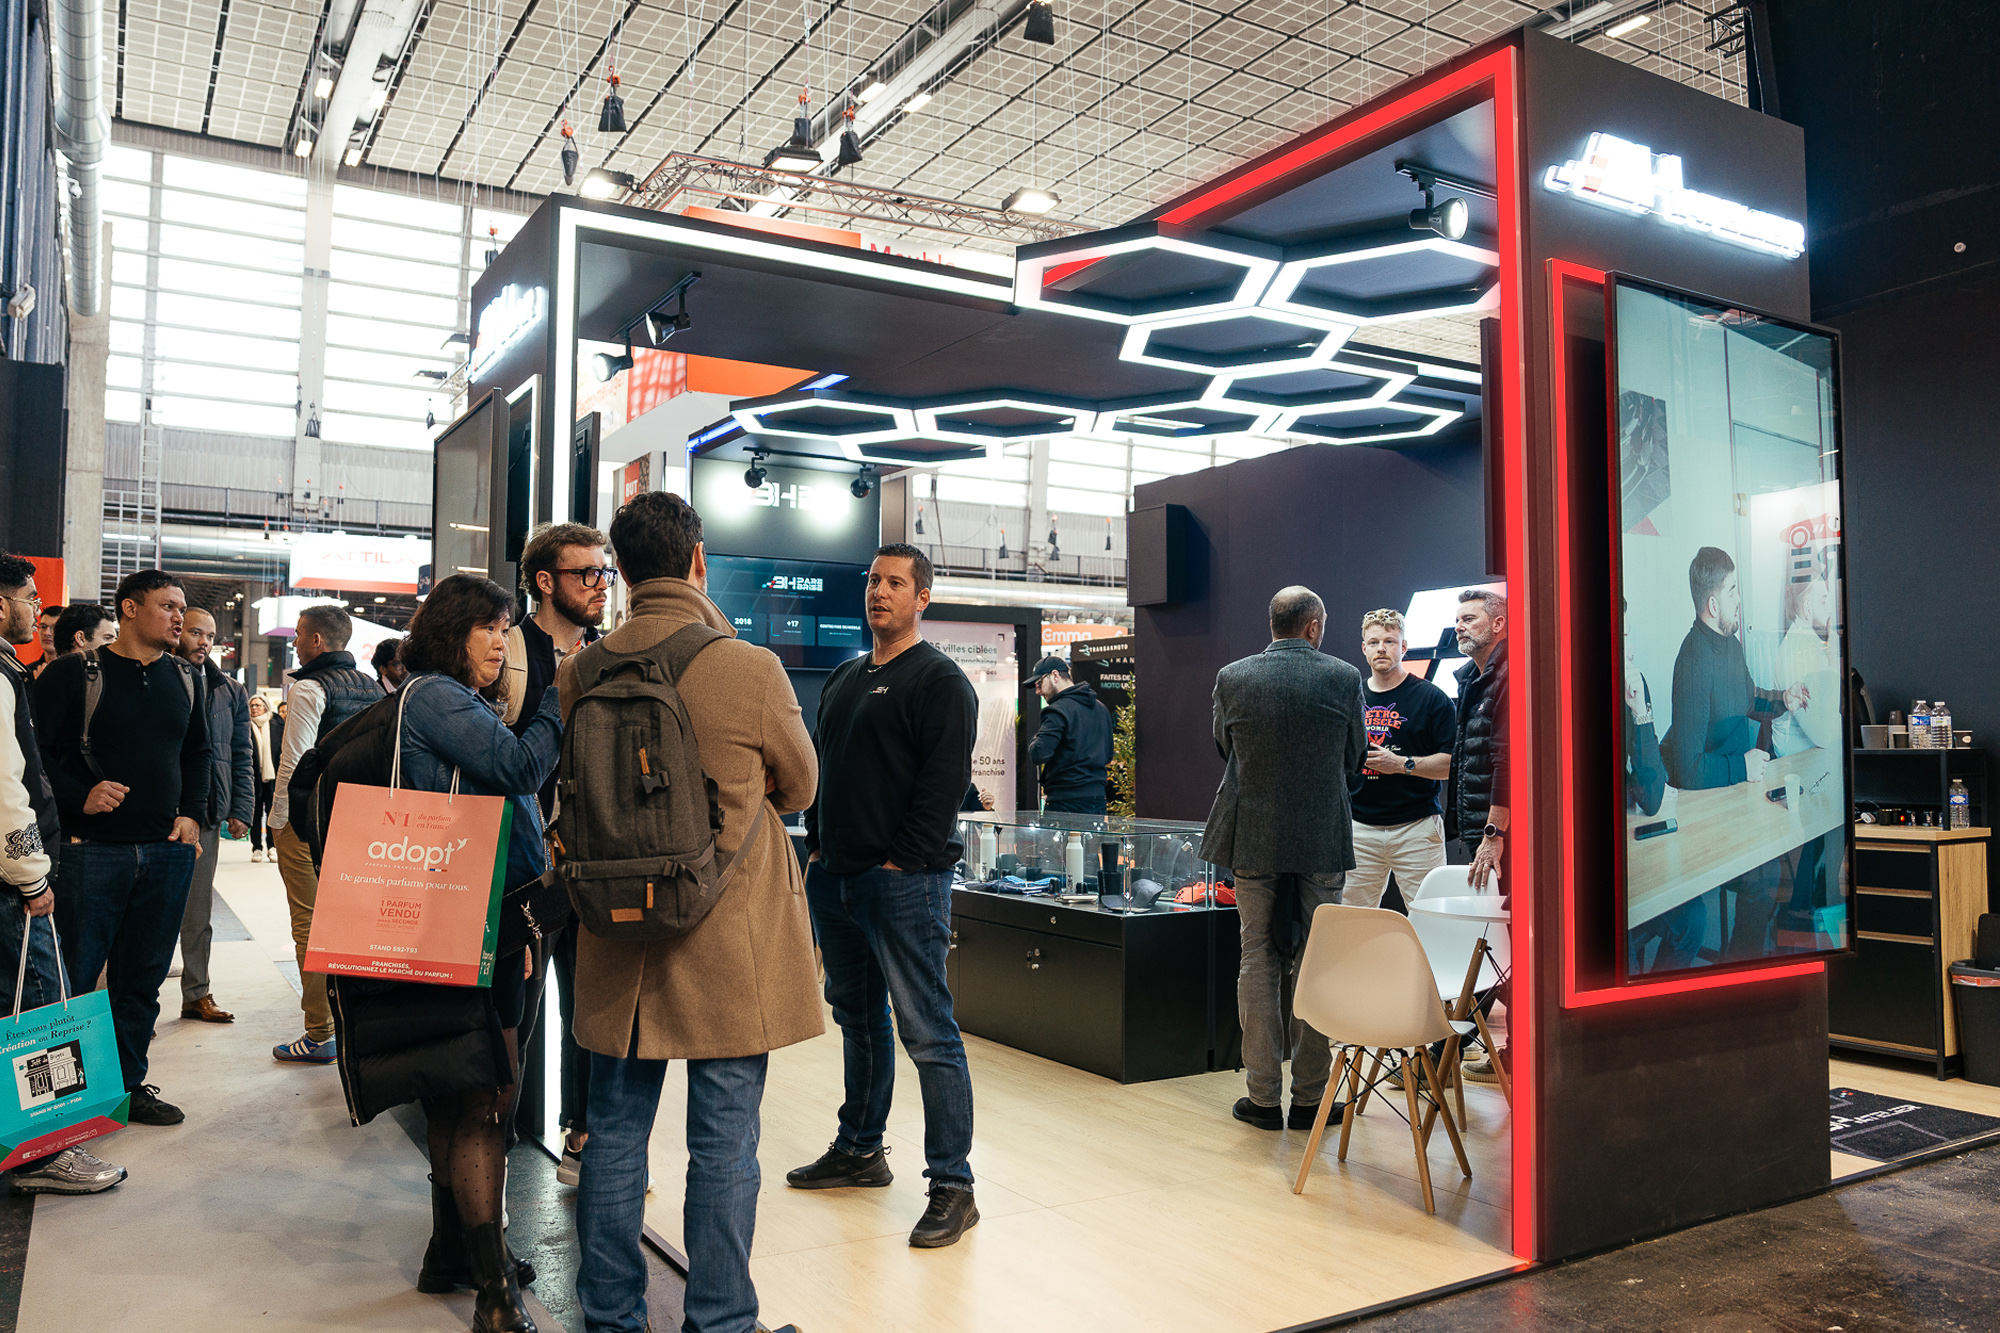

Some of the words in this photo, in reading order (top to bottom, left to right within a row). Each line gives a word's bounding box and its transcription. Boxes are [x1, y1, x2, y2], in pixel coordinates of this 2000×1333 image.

[626, 480, 638, 498] BUT
[943, 644, 966, 653] villes
[968, 645, 998, 654] ciblées
[1364, 710, 1400, 719] ETRO
[1365, 718, 1402, 730] USCLE
[980, 756, 991, 765] 50
[427, 814, 452, 823] parfum
[368, 836, 455, 872] adopt
[340, 872, 352, 880] De
[354, 875, 384, 885] grands
[386, 876, 424, 888] parfums
[425, 881, 447, 890] pour
[449, 882, 470, 891] tous.
[386, 901, 422, 909] PARFUM
[380, 908, 420, 919] VENDU
[328, 963, 380, 973] RÉVOLUTIONNEZ
[5, 1024, 48, 1041] Êtes-vous
[50, 1014, 75, 1030] plutôt
[50, 1024, 84, 1039] Reprise
[30, 1109, 46, 1118] STAND
